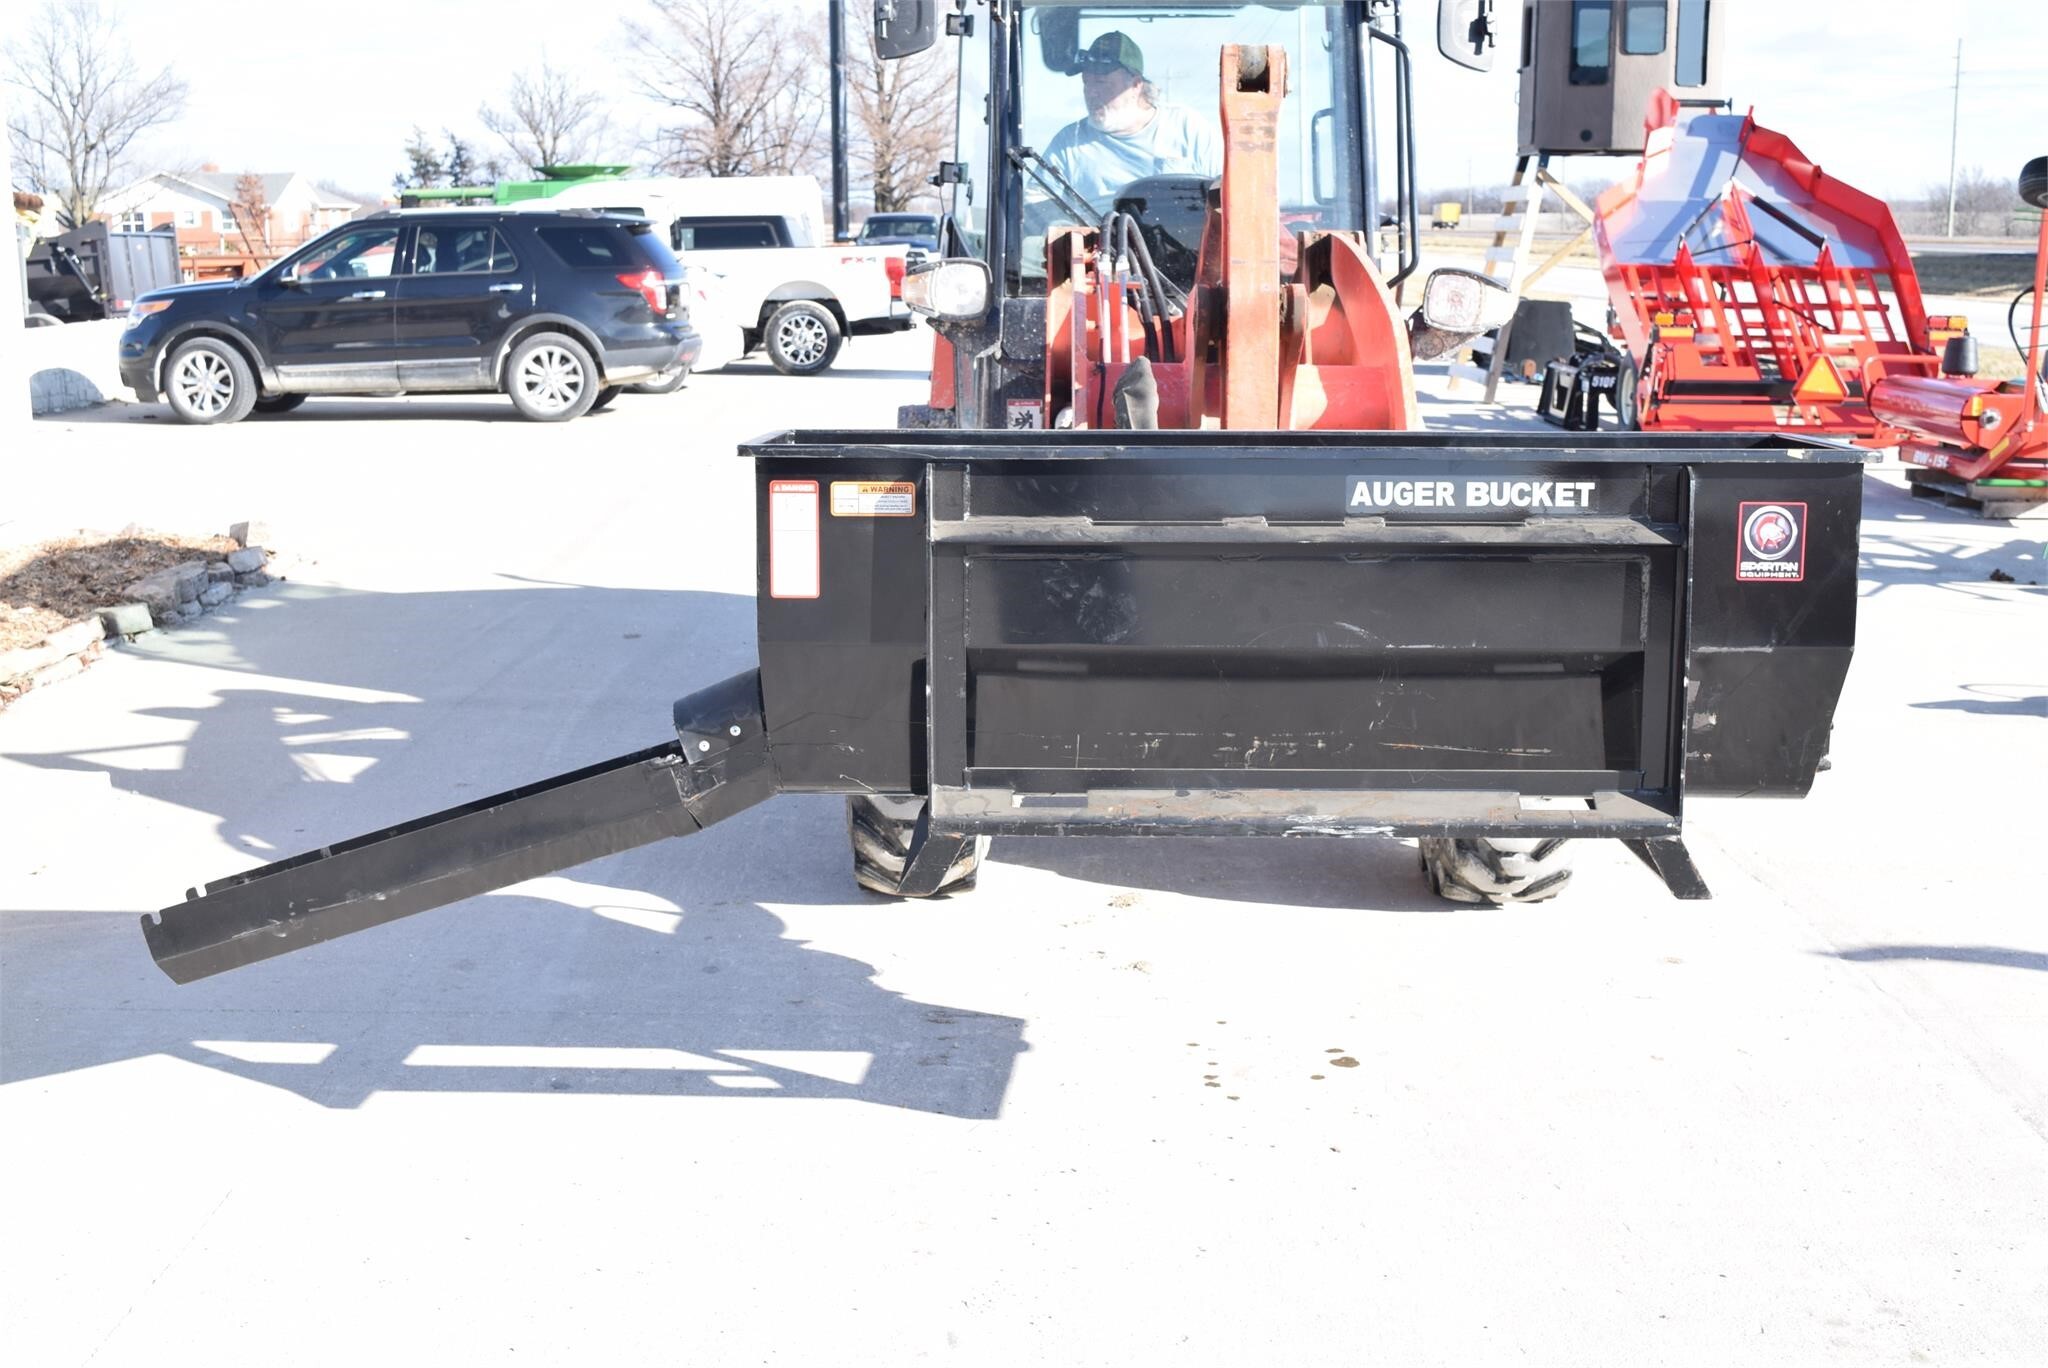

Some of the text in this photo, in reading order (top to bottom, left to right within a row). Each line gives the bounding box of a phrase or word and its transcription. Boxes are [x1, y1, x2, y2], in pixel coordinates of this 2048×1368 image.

[841, 256, 877, 265] FX4
[1351, 483, 1596, 507] AUGER BUCKET
[1740, 561, 1799, 572] SPARTAN
